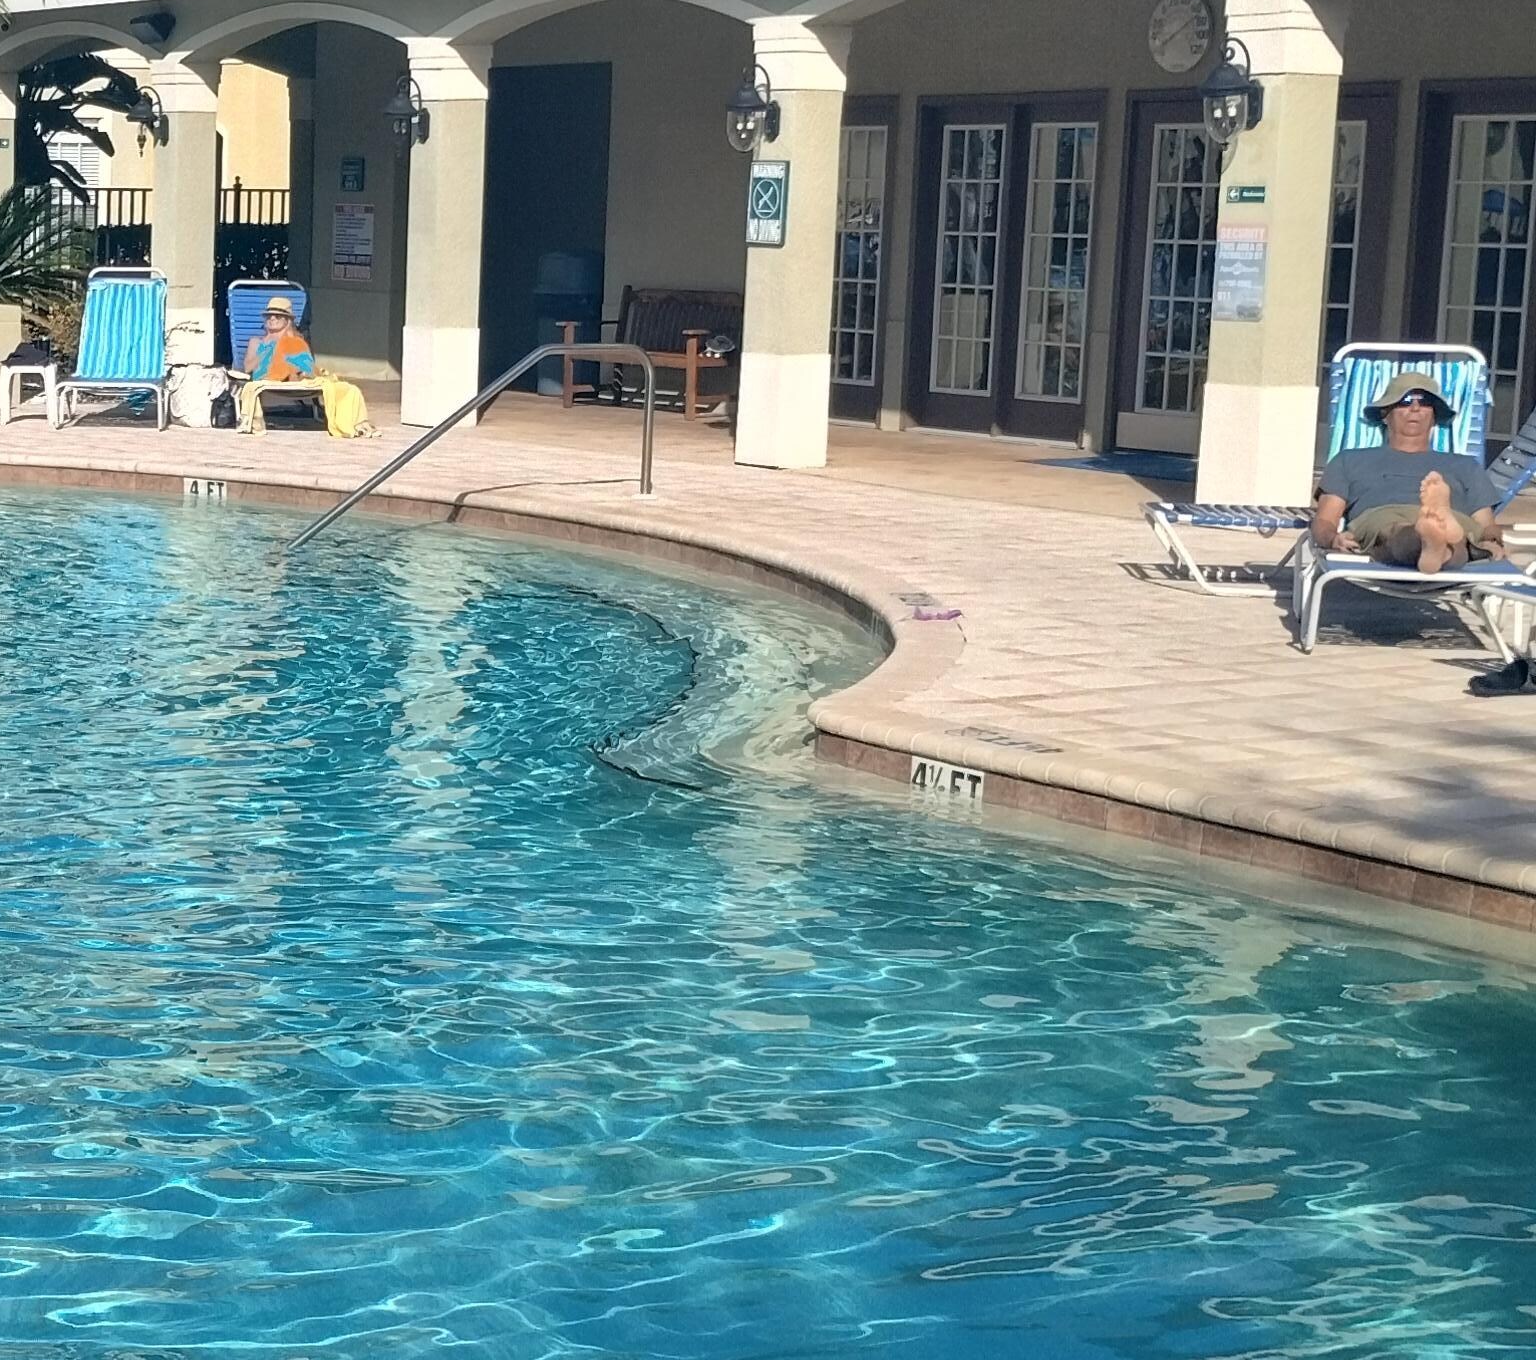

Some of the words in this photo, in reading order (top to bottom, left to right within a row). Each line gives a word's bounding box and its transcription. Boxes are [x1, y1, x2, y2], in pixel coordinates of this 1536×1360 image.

[1220, 226, 1265, 240] SECURITY
[1236, 242, 1255, 250] AREA
[190, 480, 199, 494] 4
[207, 482, 224, 500] FT
[950, 770, 982, 799] FT
